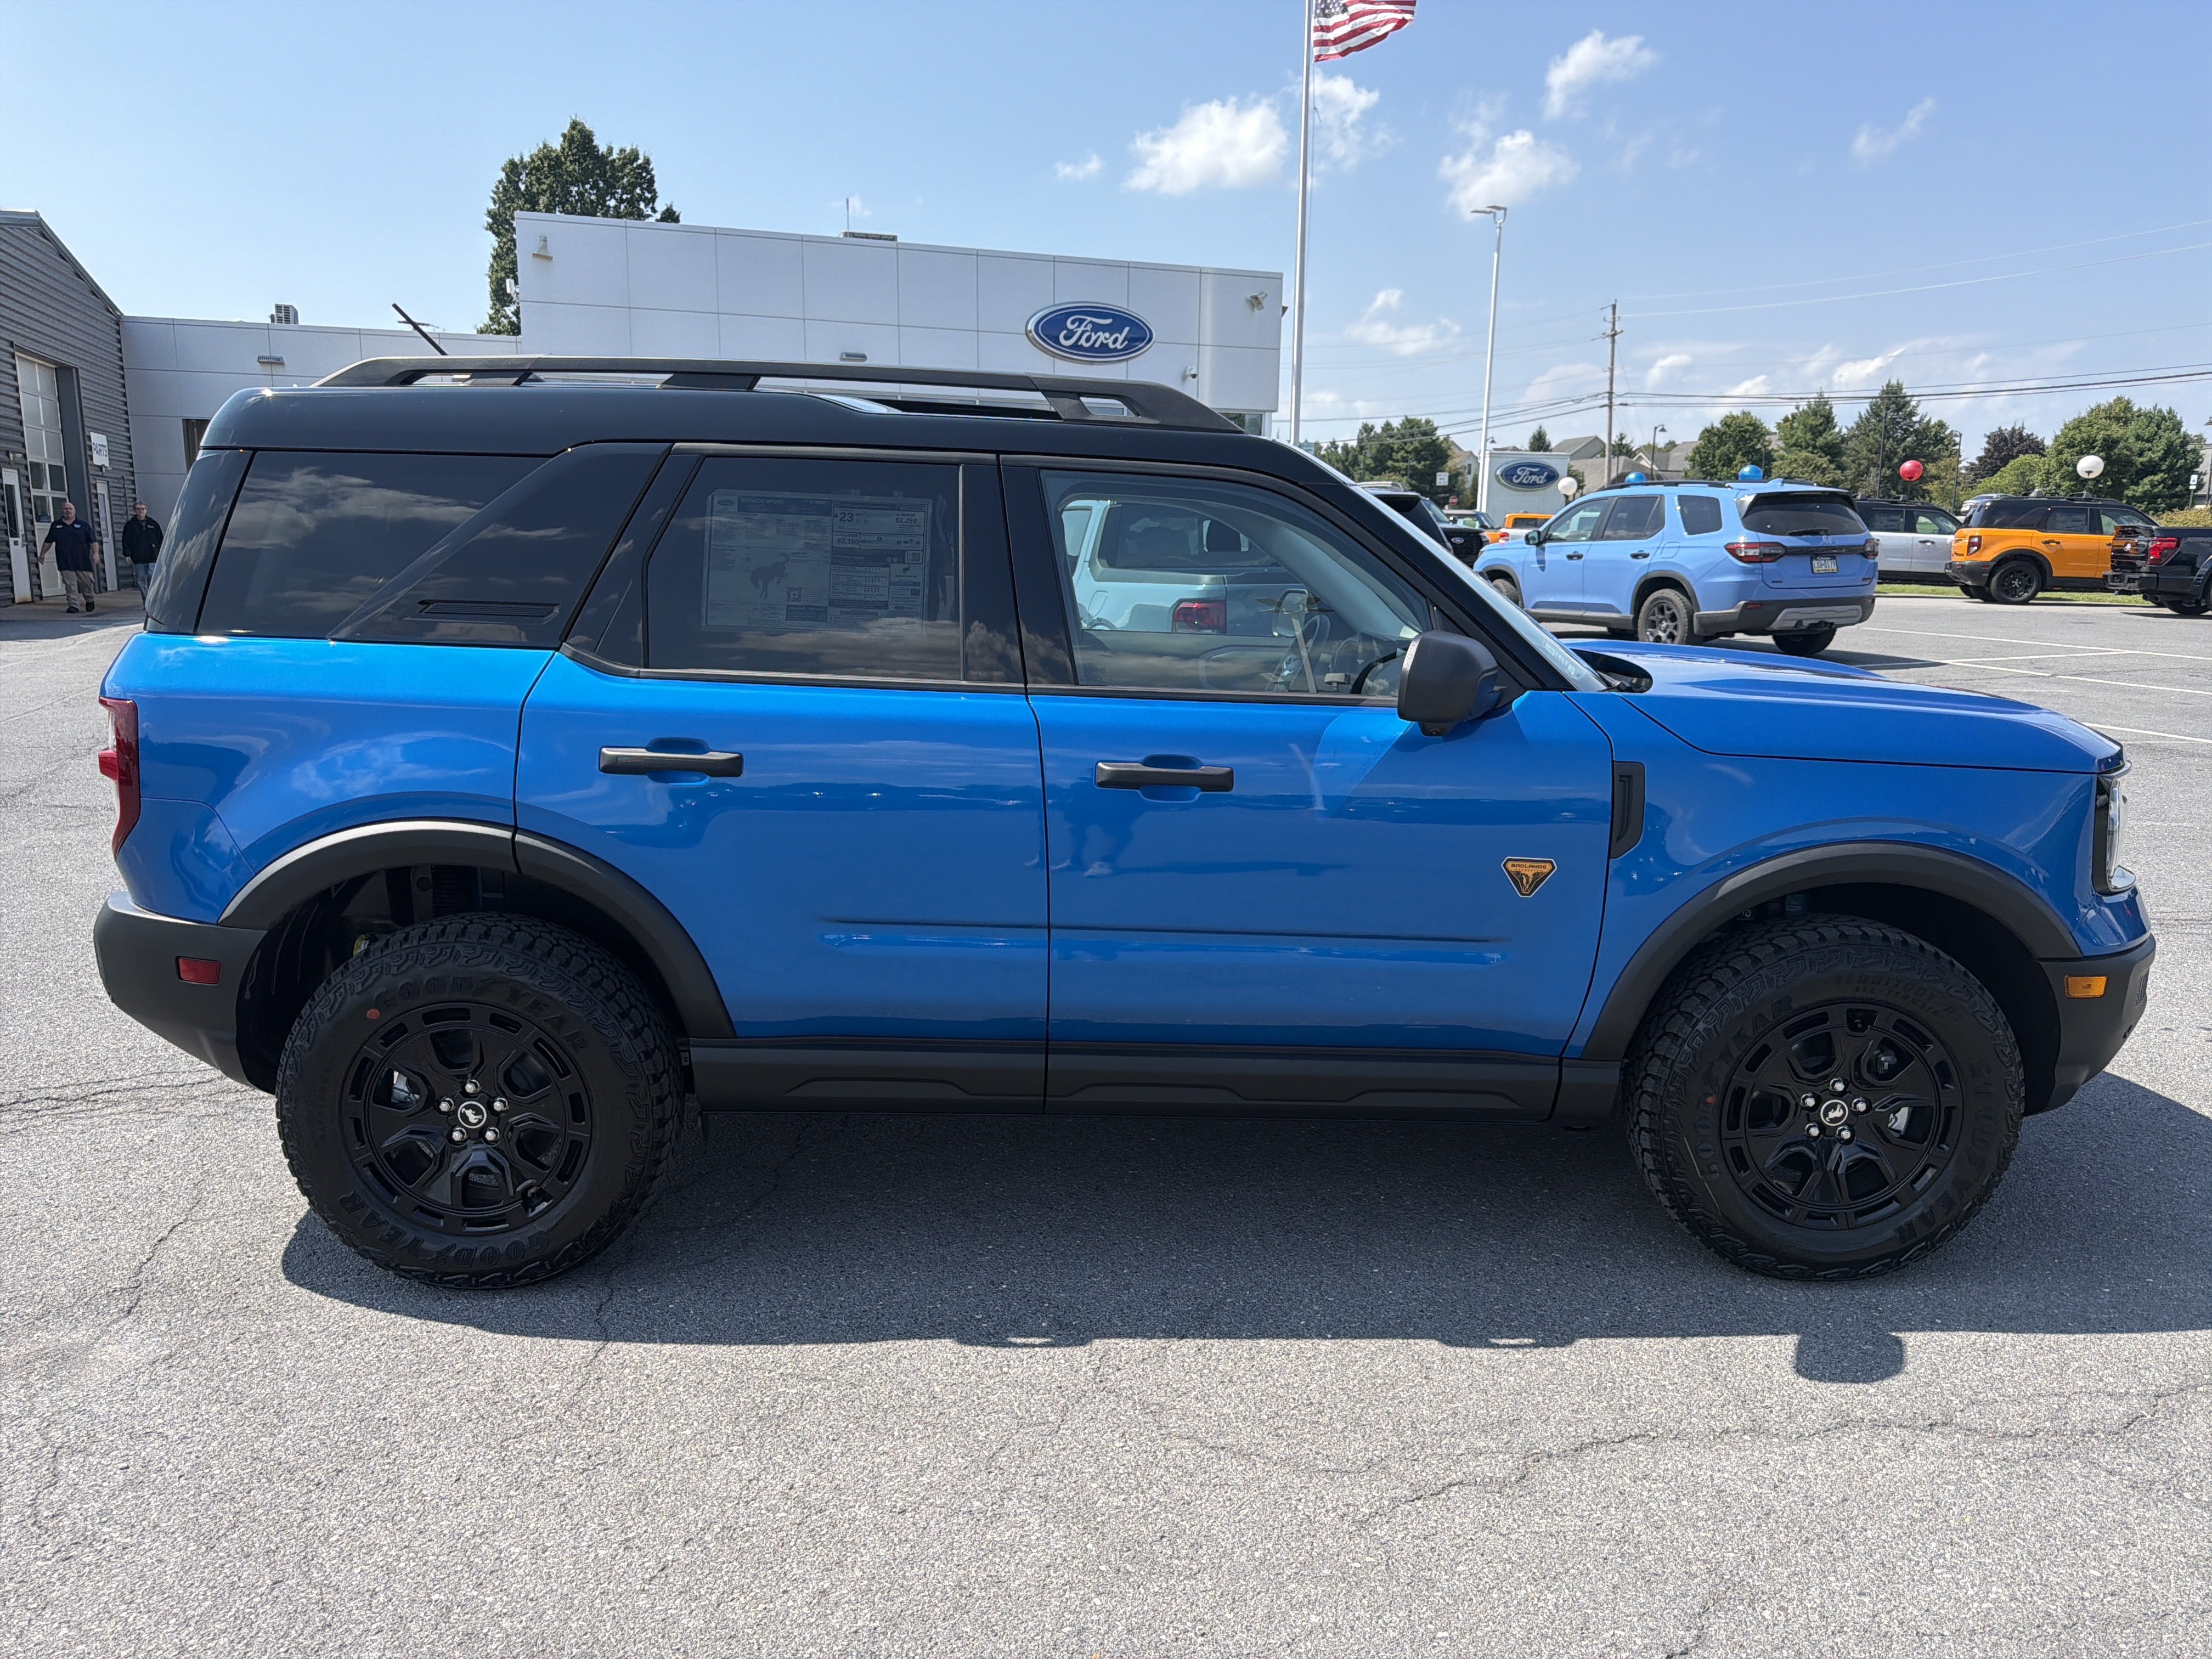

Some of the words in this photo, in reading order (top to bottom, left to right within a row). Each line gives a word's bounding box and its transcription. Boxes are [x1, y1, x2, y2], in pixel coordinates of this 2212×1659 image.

[1059, 315, 1130, 350] Ford
[92, 442, 108, 458] PARTS
[1512, 466, 1548, 484] Ford
[839, 512, 854, 522] 23
